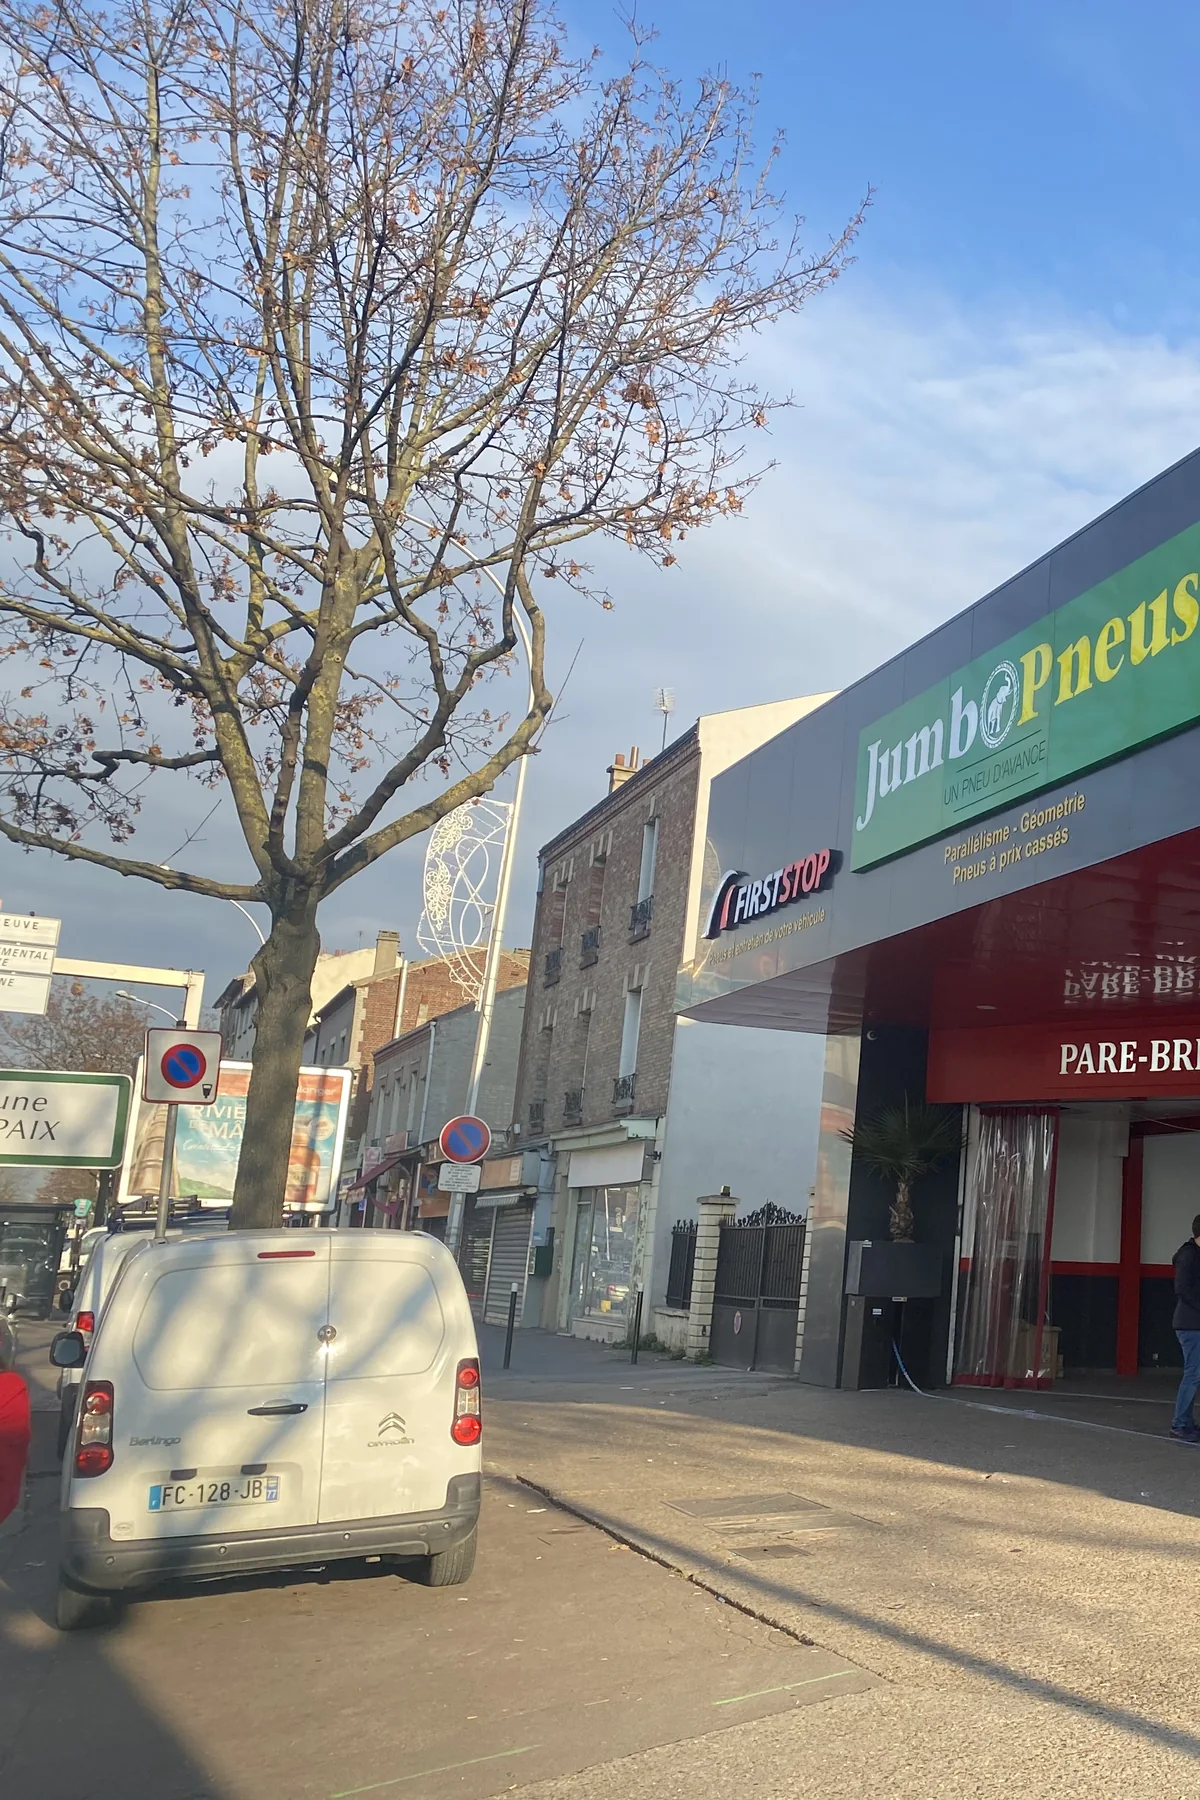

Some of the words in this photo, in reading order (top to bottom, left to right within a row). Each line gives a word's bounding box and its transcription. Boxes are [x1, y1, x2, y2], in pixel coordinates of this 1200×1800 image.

[944, 782, 960, 805] UN
[961, 768, 991, 798] PNEU
[992, 740, 1047, 783] D'AVANCE
[944, 825, 1011, 866] Parallélisme
[952, 858, 988, 885] Pneus
[989, 852, 997, 872] à
[999, 840, 1023, 873] prix
[1025, 824, 1070, 858] cassés
[3, 918, 40, 930] EUVE
[0, 947, 49, 961] MENTAL
[129, 1435, 182, 1447] Berlingo
